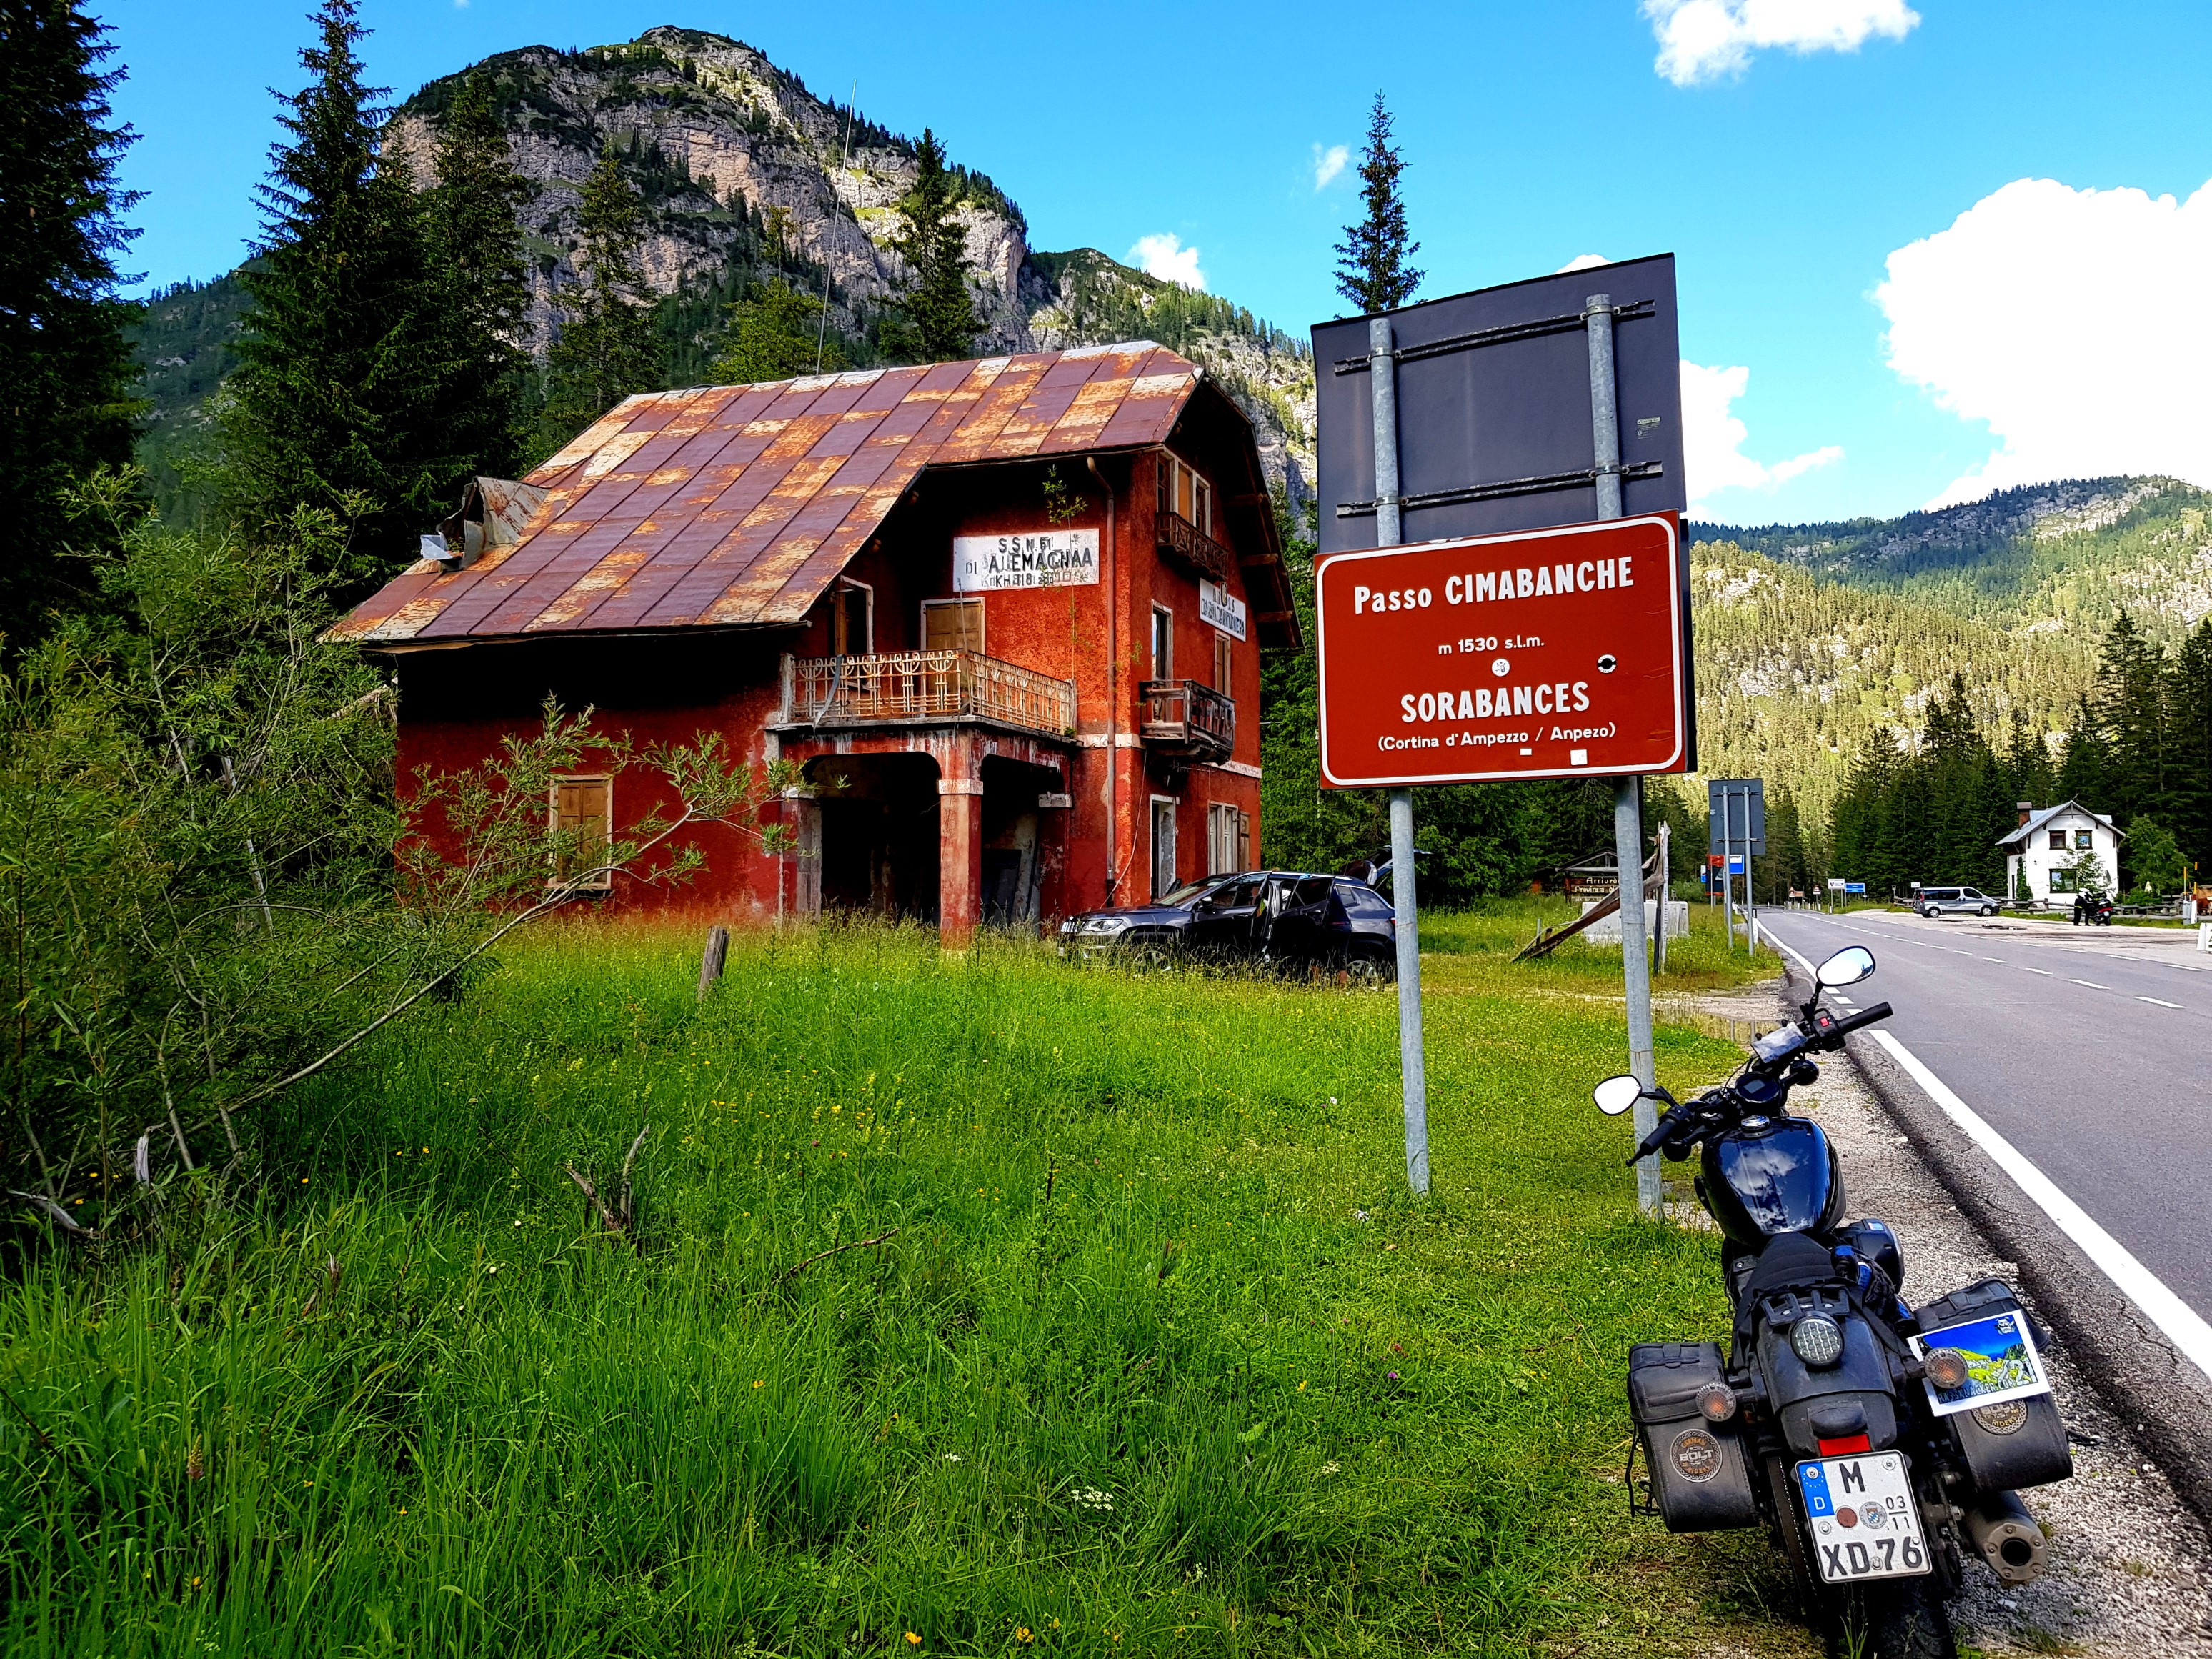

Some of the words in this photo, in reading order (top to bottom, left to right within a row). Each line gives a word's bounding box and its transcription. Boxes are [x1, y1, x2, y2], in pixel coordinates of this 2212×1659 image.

[1354, 586, 1432, 614] Passo
[1445, 556, 1634, 605] CIMABANCHE
[1438, 644, 1453, 655] m
[1458, 637, 1498, 653] 1530
[1504, 635, 1545, 649] s.l.m.
[1400, 681, 1590, 723] SORABANCES
[1378, 736, 1440, 752] (Cortina
[1550, 722, 1616, 742] Anpezo)
[1679, 1449, 1714, 1462] BOLT
[1838, 1461, 1865, 1494] M
[1813, 1496, 1826, 1510] D
[1885, 1495, 1906, 1510] 03
